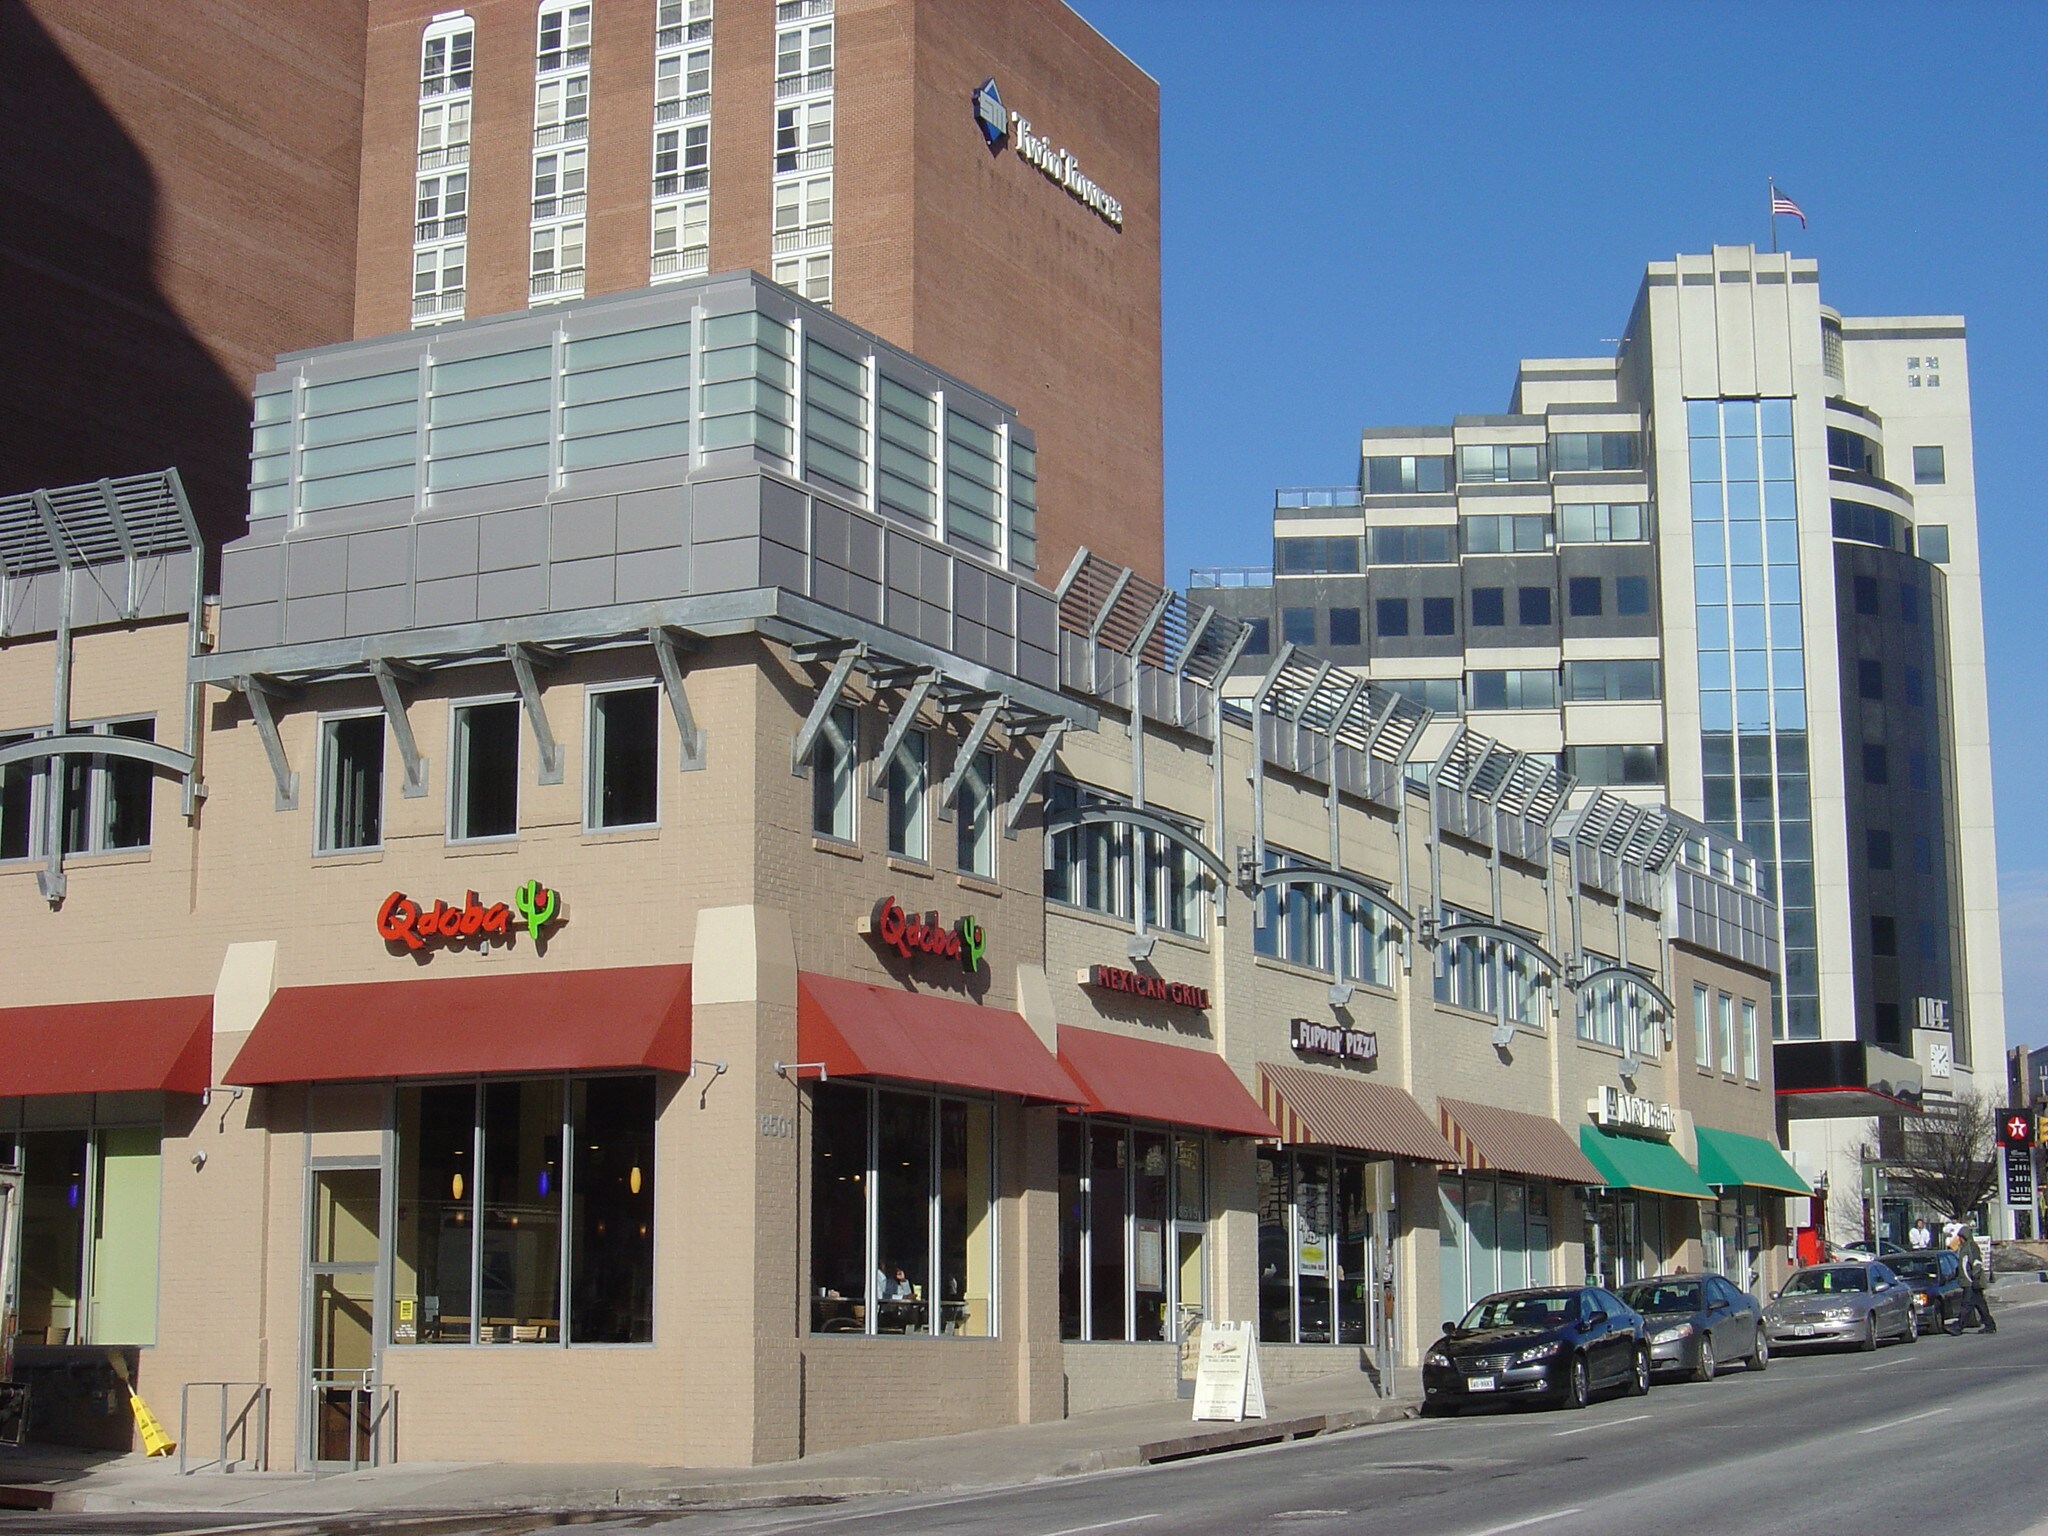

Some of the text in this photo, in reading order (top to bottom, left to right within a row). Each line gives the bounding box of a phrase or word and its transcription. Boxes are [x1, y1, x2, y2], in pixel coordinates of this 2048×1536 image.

[1011, 111, 1123, 224] Twin Towers
[376, 888, 511, 950] Qdoba
[876, 894, 962, 960] Qdoba
[1095, 964, 1213, 1010] MEXICAN GRILL
[1345, 1031, 1377, 1059] PIZZA
[759, 1114, 795, 1139] 8501
[1643, 1100, 1676, 1133] Bank
